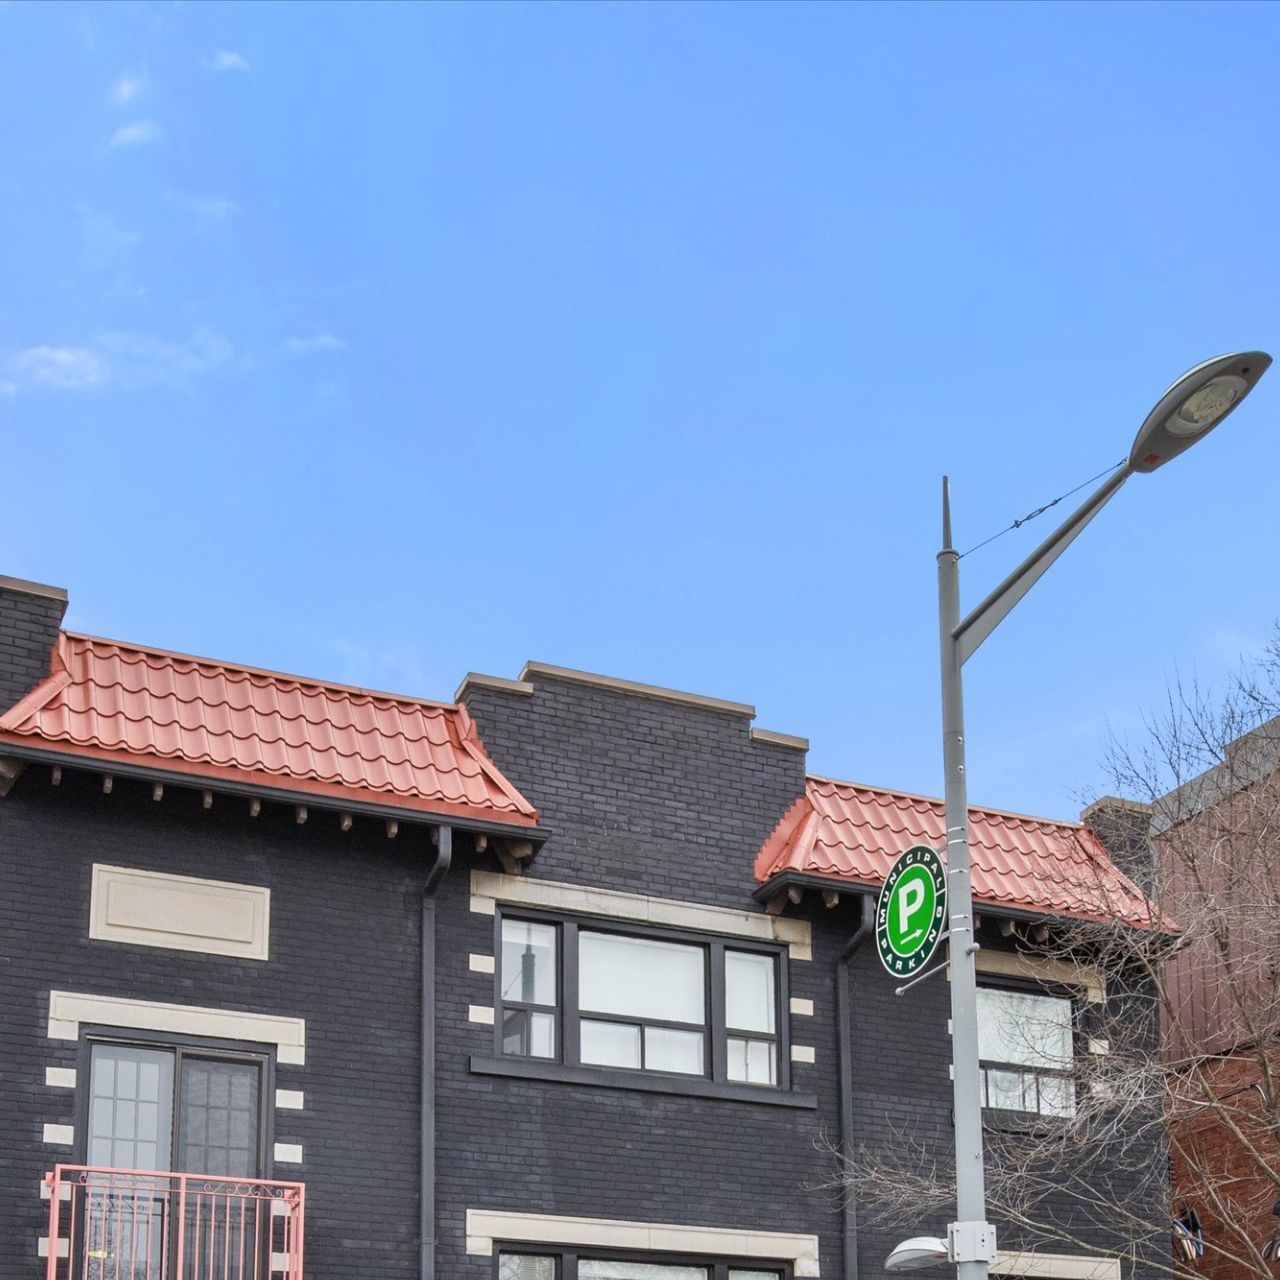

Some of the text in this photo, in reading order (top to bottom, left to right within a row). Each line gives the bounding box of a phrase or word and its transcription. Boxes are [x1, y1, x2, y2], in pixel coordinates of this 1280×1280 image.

[879, 851, 943, 923] MUNICIPAL
[898, 878, 925, 935] P
[880, 906, 942, 971] PARKING
